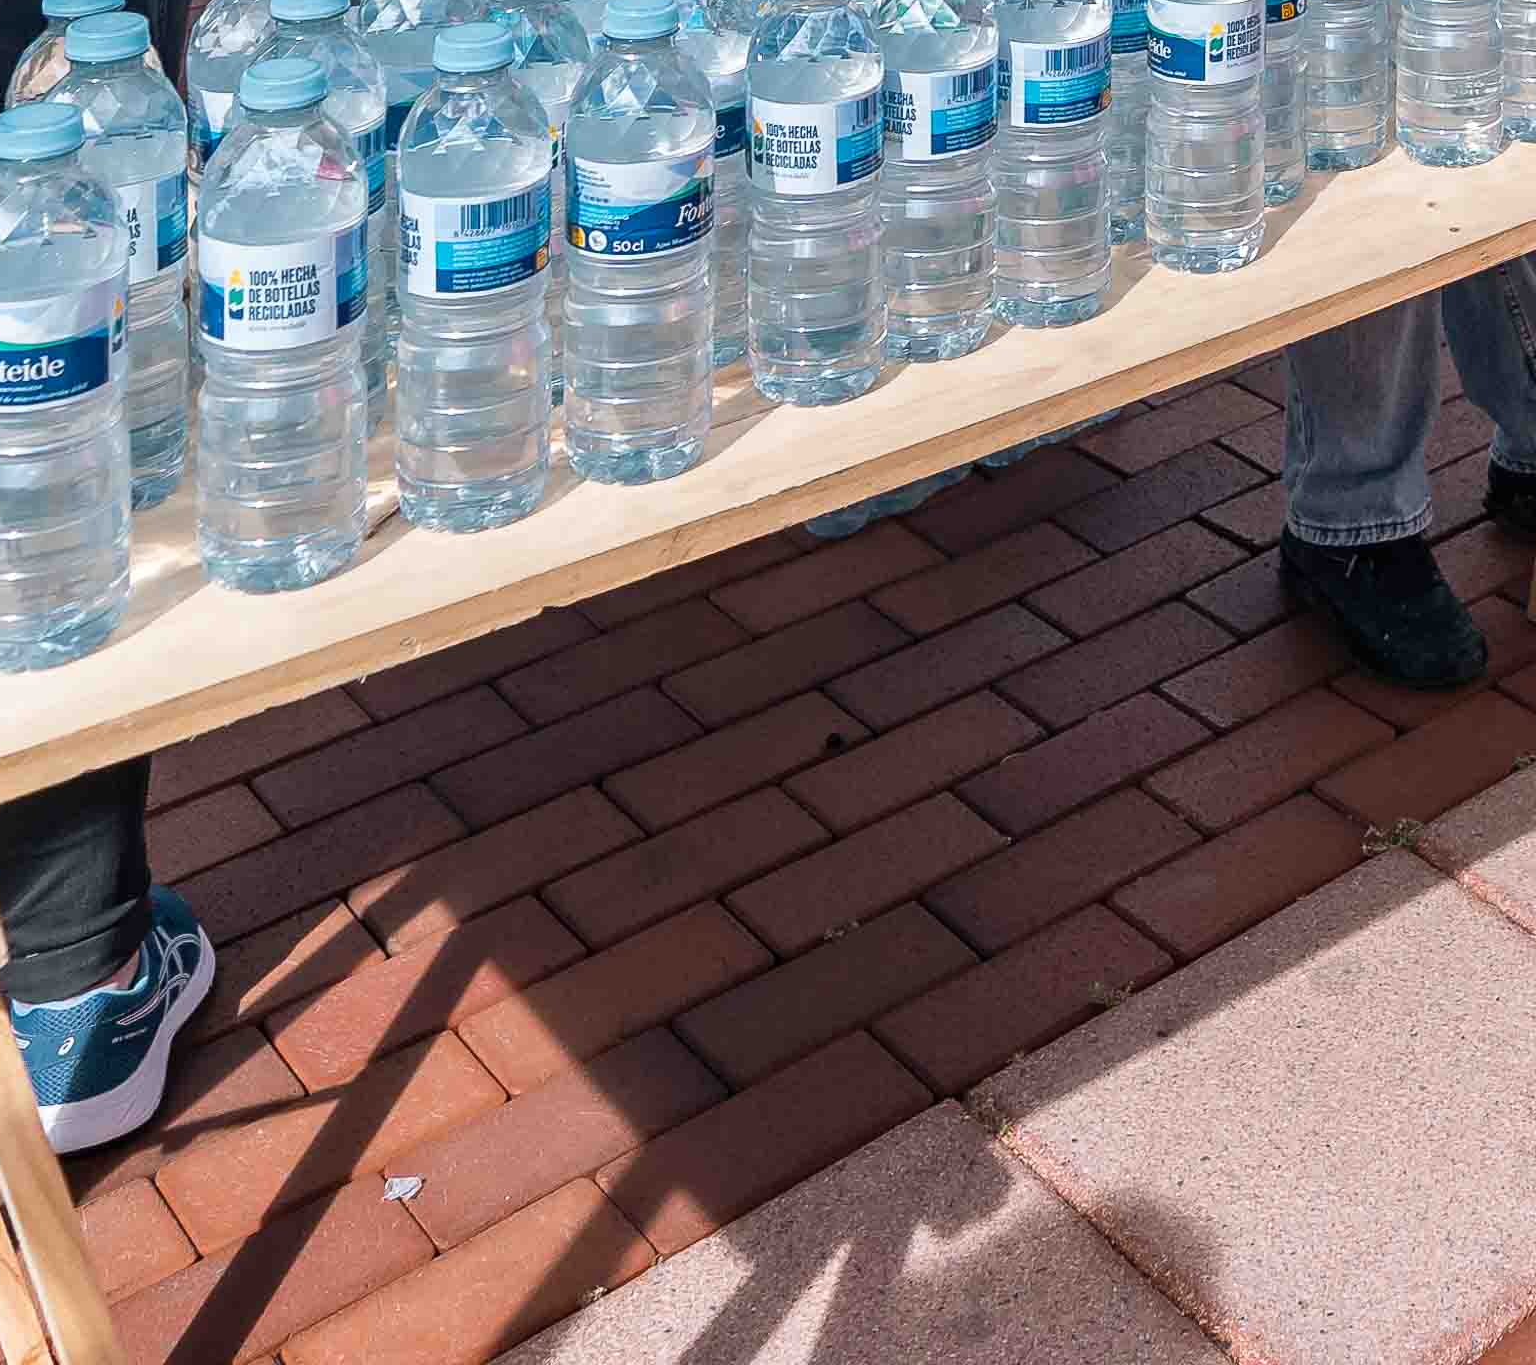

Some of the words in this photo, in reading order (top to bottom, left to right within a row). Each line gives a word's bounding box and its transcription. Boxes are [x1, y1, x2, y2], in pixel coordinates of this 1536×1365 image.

[1227, 35, 1236, 47] DE
[765, 123, 786, 139] 100%
[787, 124, 818, 139] HECHA
[765, 139, 776, 153] DE
[776, 139, 821, 155] BOTELLAS
[765, 152, 818, 169] RECICLADAS
[612, 239, 644, 253] 50cl
[249, 269, 279, 287] 100%
[280, 263, 318, 283] HECHA
[248, 287, 262, 304] DE
[263, 280, 321, 303] BOTELLAS
[248, 298, 316, 321] RECICLADAS
